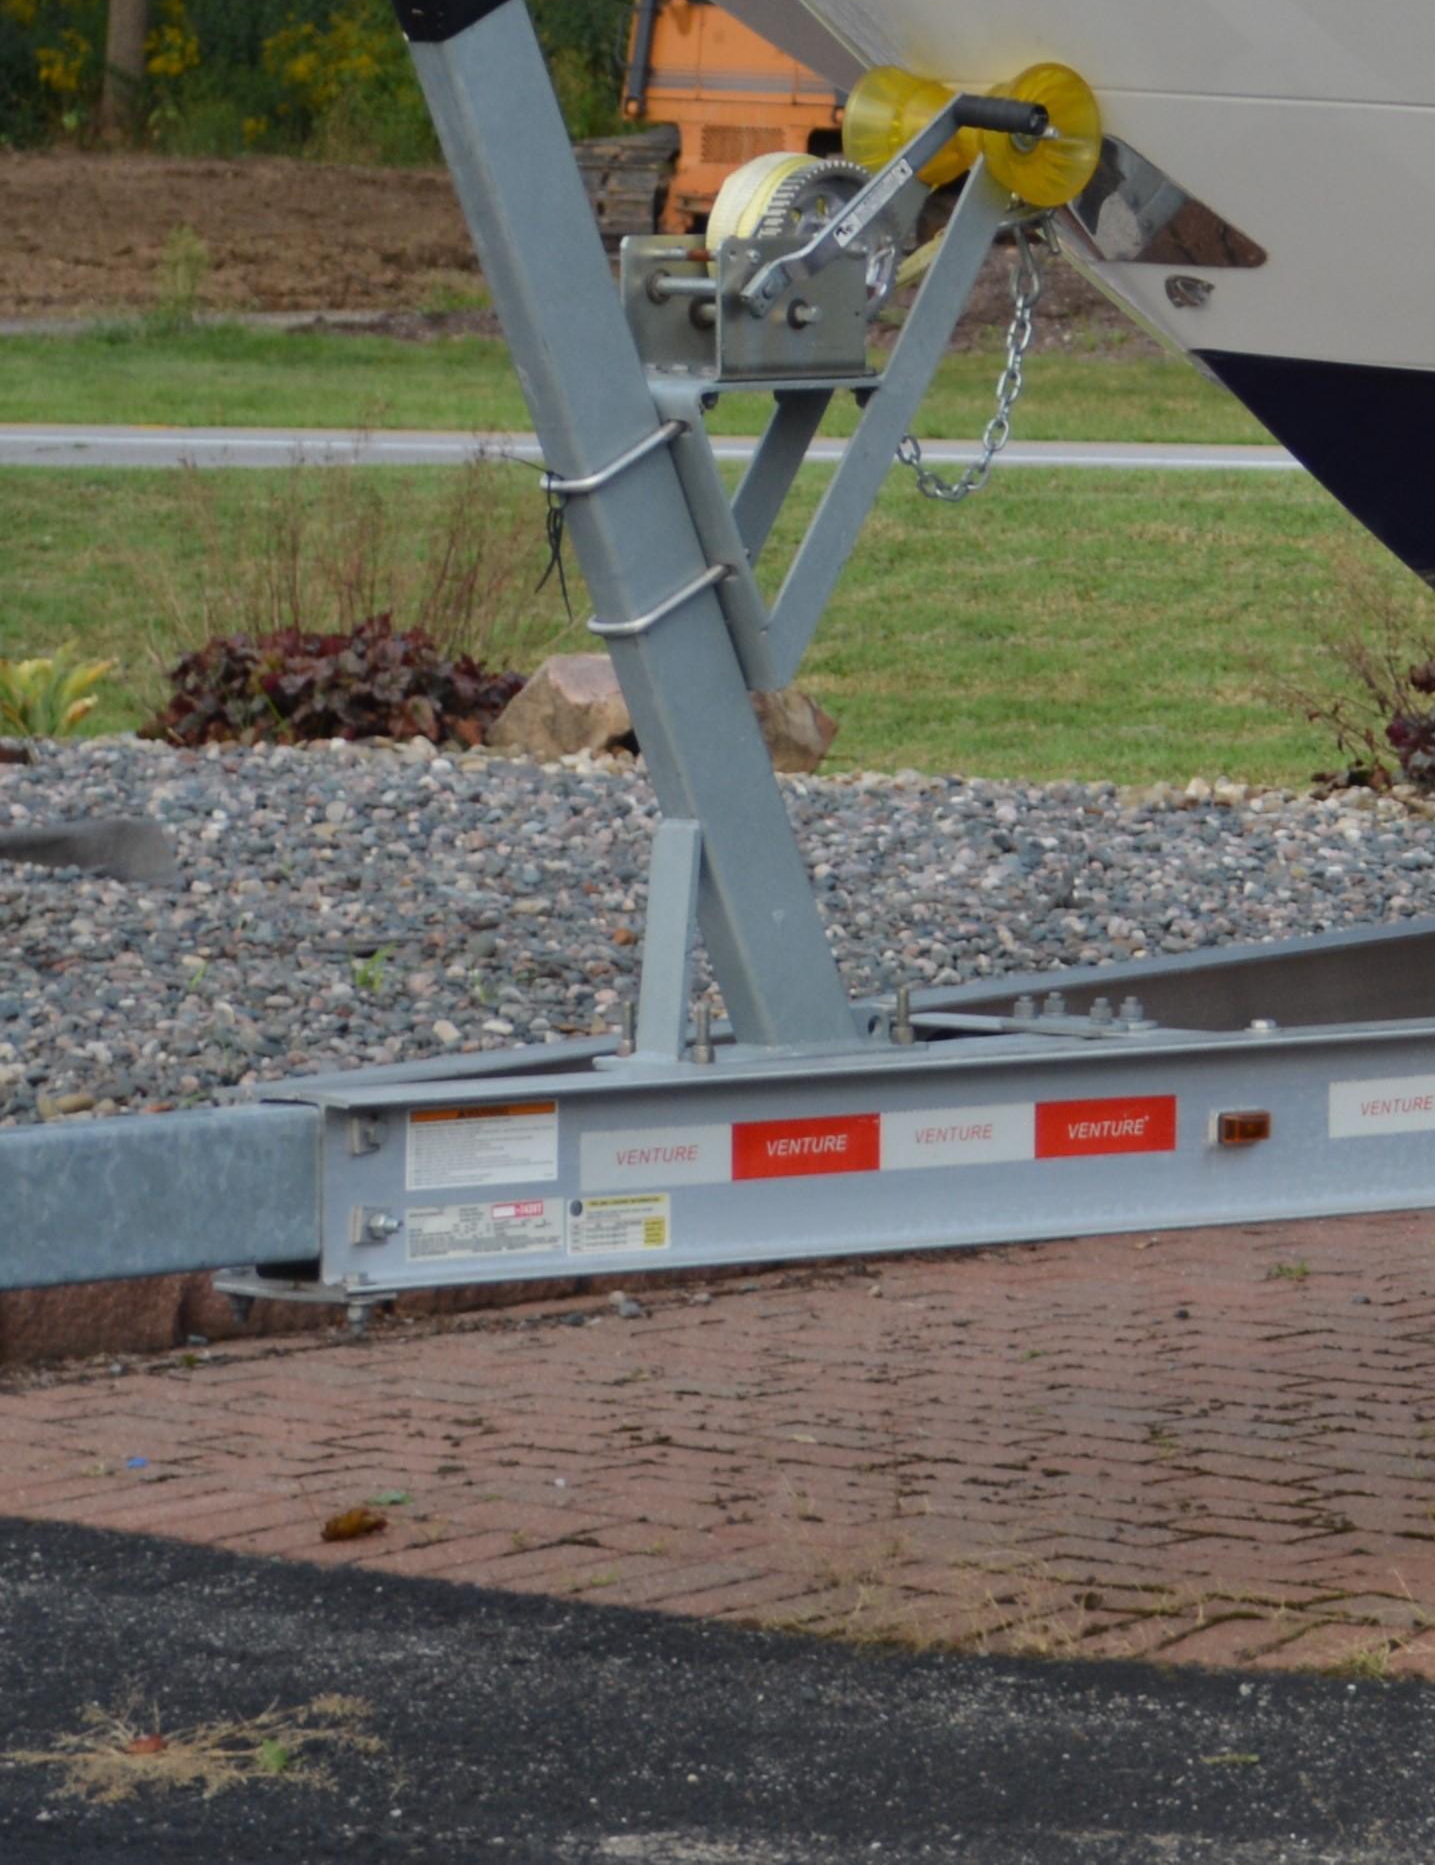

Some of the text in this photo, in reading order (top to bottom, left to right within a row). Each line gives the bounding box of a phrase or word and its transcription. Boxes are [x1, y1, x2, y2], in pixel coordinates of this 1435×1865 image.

[1360, 1095, 1434, 1116] VENTURE
[616, 1118, 1146, 1166] VENTURE VENTURE VENTURE VENTURE
